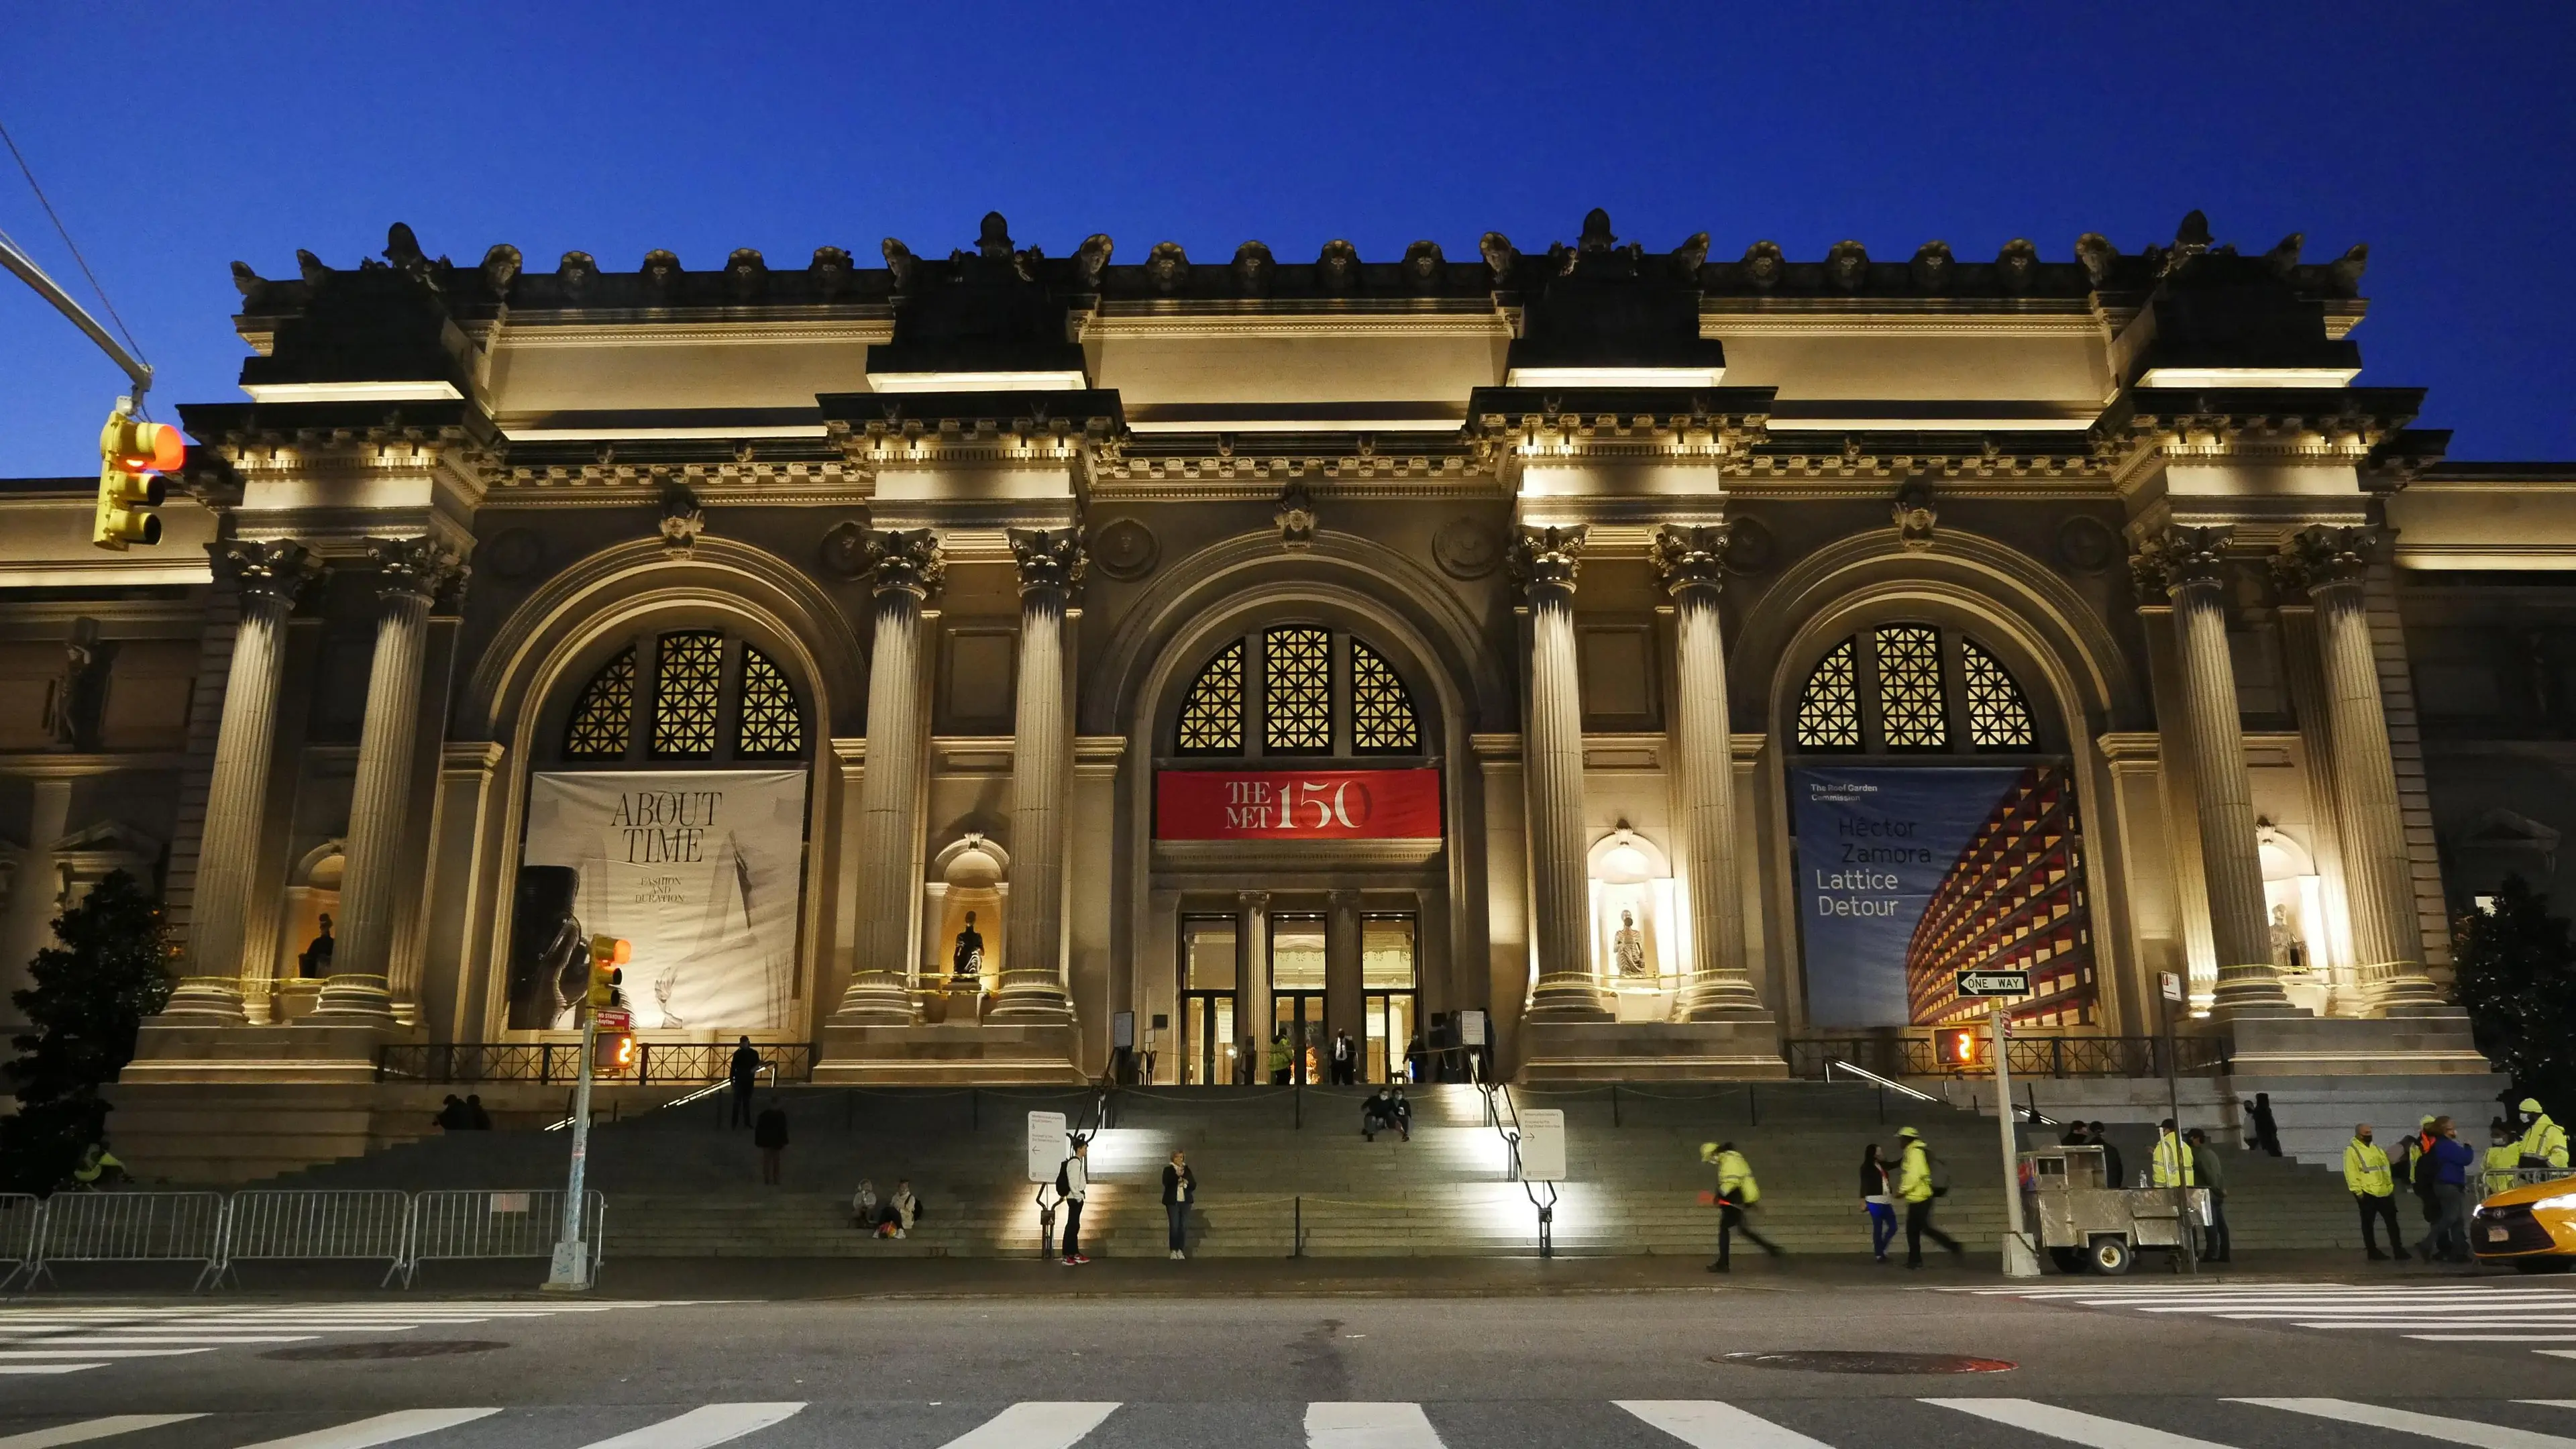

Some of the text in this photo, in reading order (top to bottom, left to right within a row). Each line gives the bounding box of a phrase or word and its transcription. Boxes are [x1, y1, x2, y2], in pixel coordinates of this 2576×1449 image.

[1225, 782, 1271, 804] THE
[1811, 784, 1878, 792] The Roof Garden
[610, 792, 722, 826] ABOUT
[1275, 781, 1373, 828] 150
[1225, 806, 1273, 828] MET
[623, 828, 704, 863] TIME
[1841, 843, 1931, 863] Zamora
[1817, 868, 1898, 890] Lattice
[1819, 896, 1899, 916] Detour
[1968, 978, 2019, 988] ONE WAY
